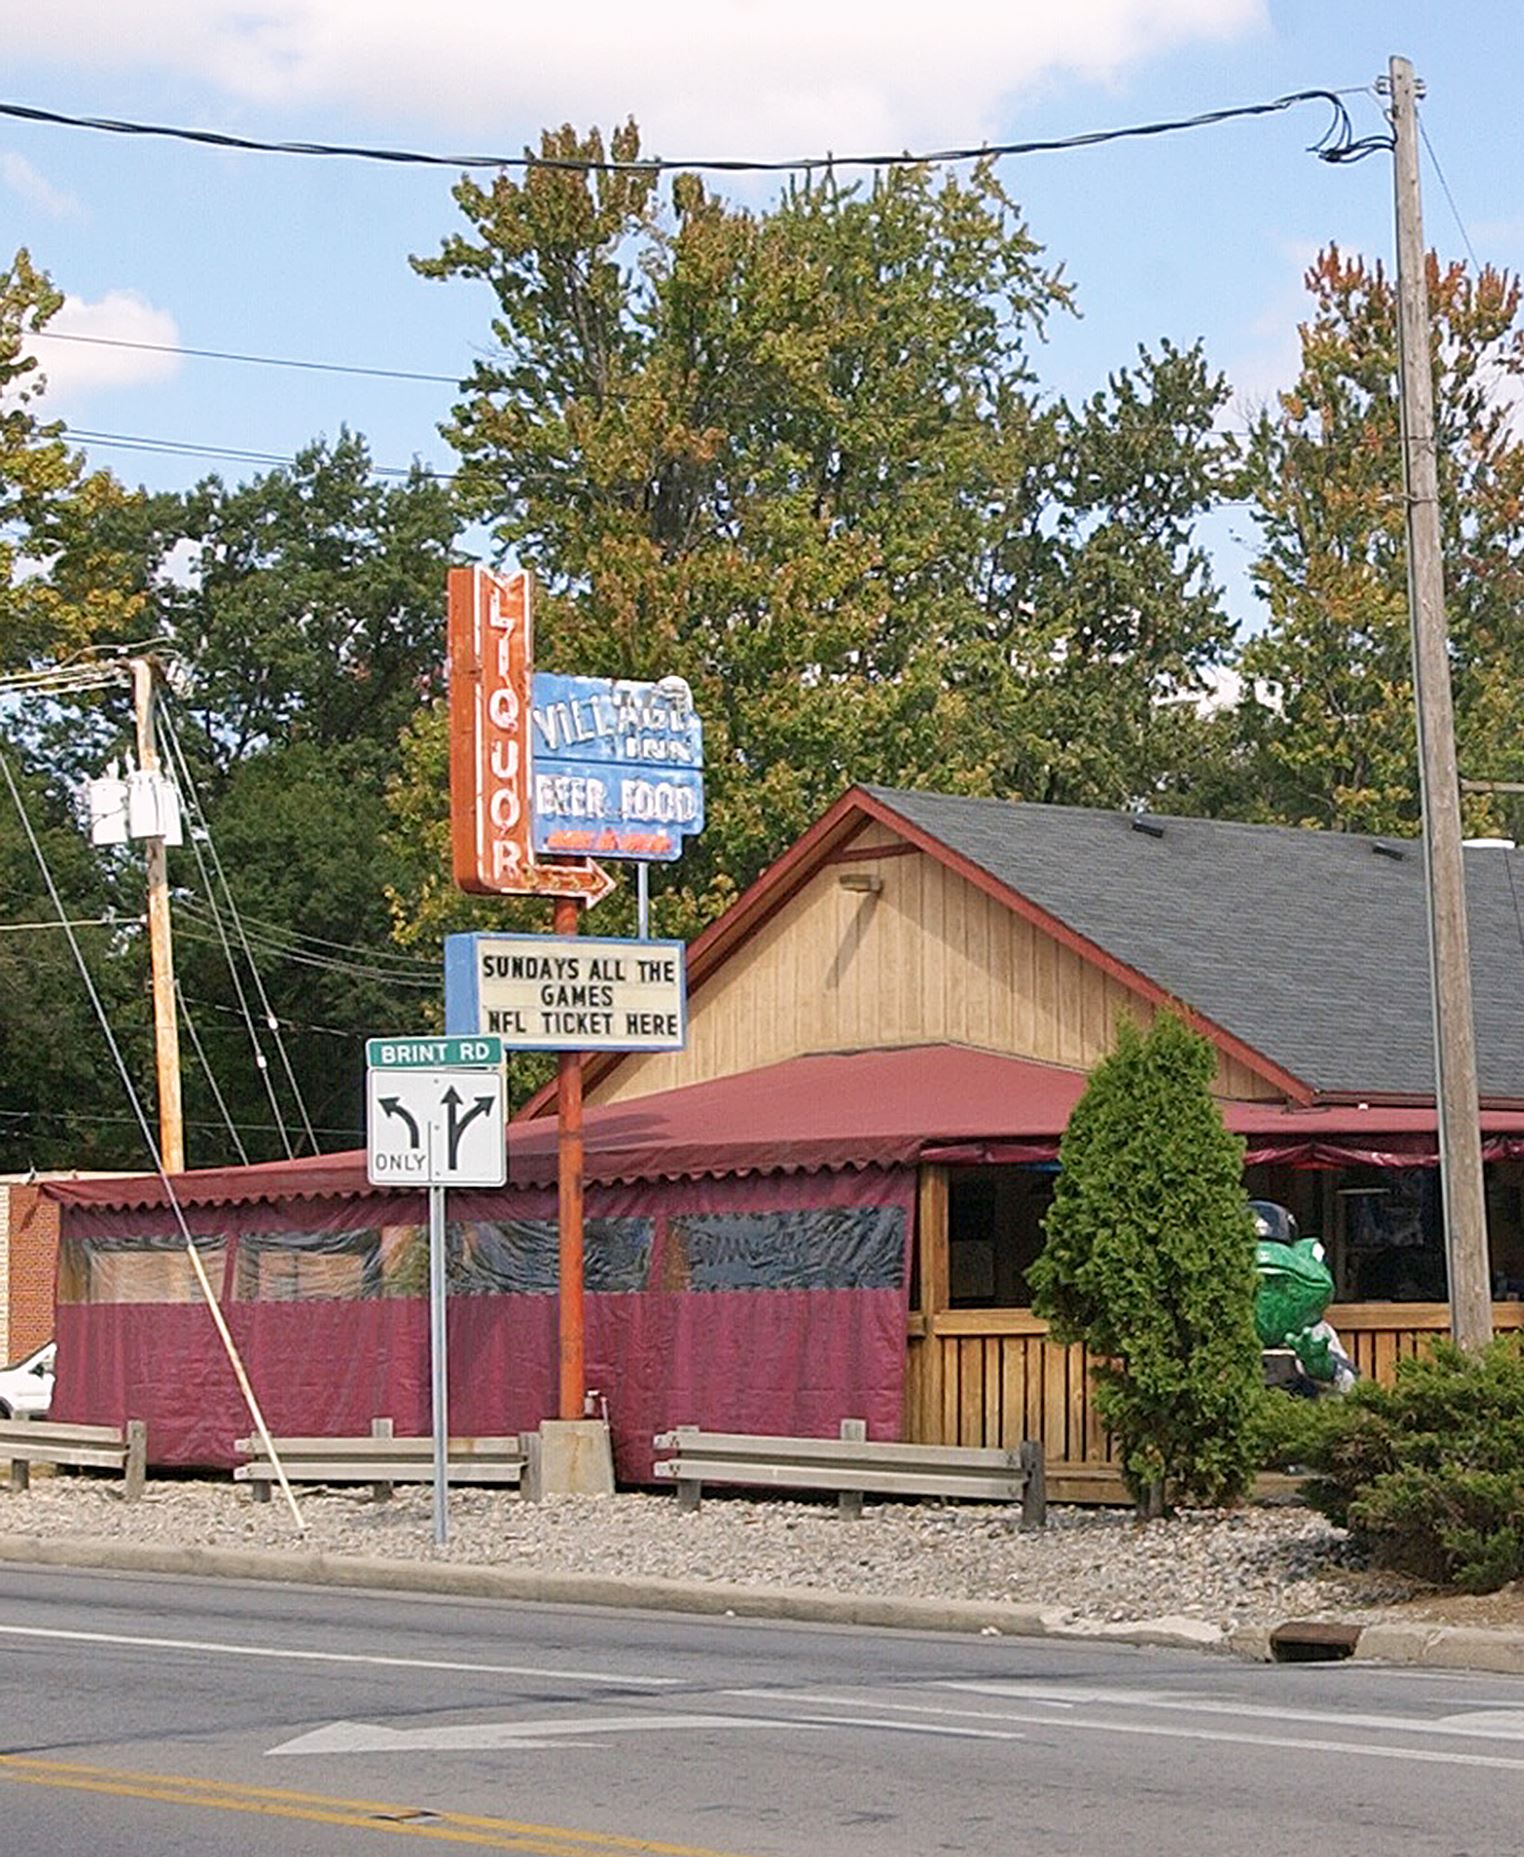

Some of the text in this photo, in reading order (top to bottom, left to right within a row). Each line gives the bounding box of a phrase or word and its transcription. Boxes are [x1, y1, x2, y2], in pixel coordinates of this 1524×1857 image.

[488, 589, 522, 881] LIQUOR
[535, 774, 697, 823] BEER FOOD
[483, 955, 675, 983] SUNDAYS ALL THE
[540, 985, 614, 1008] GAMES
[488, 1012, 678, 1036] NFL TICKET HERE
[381, 1043, 490, 1064] BRINT RD
[375, 1153, 426, 1172] ONLY
